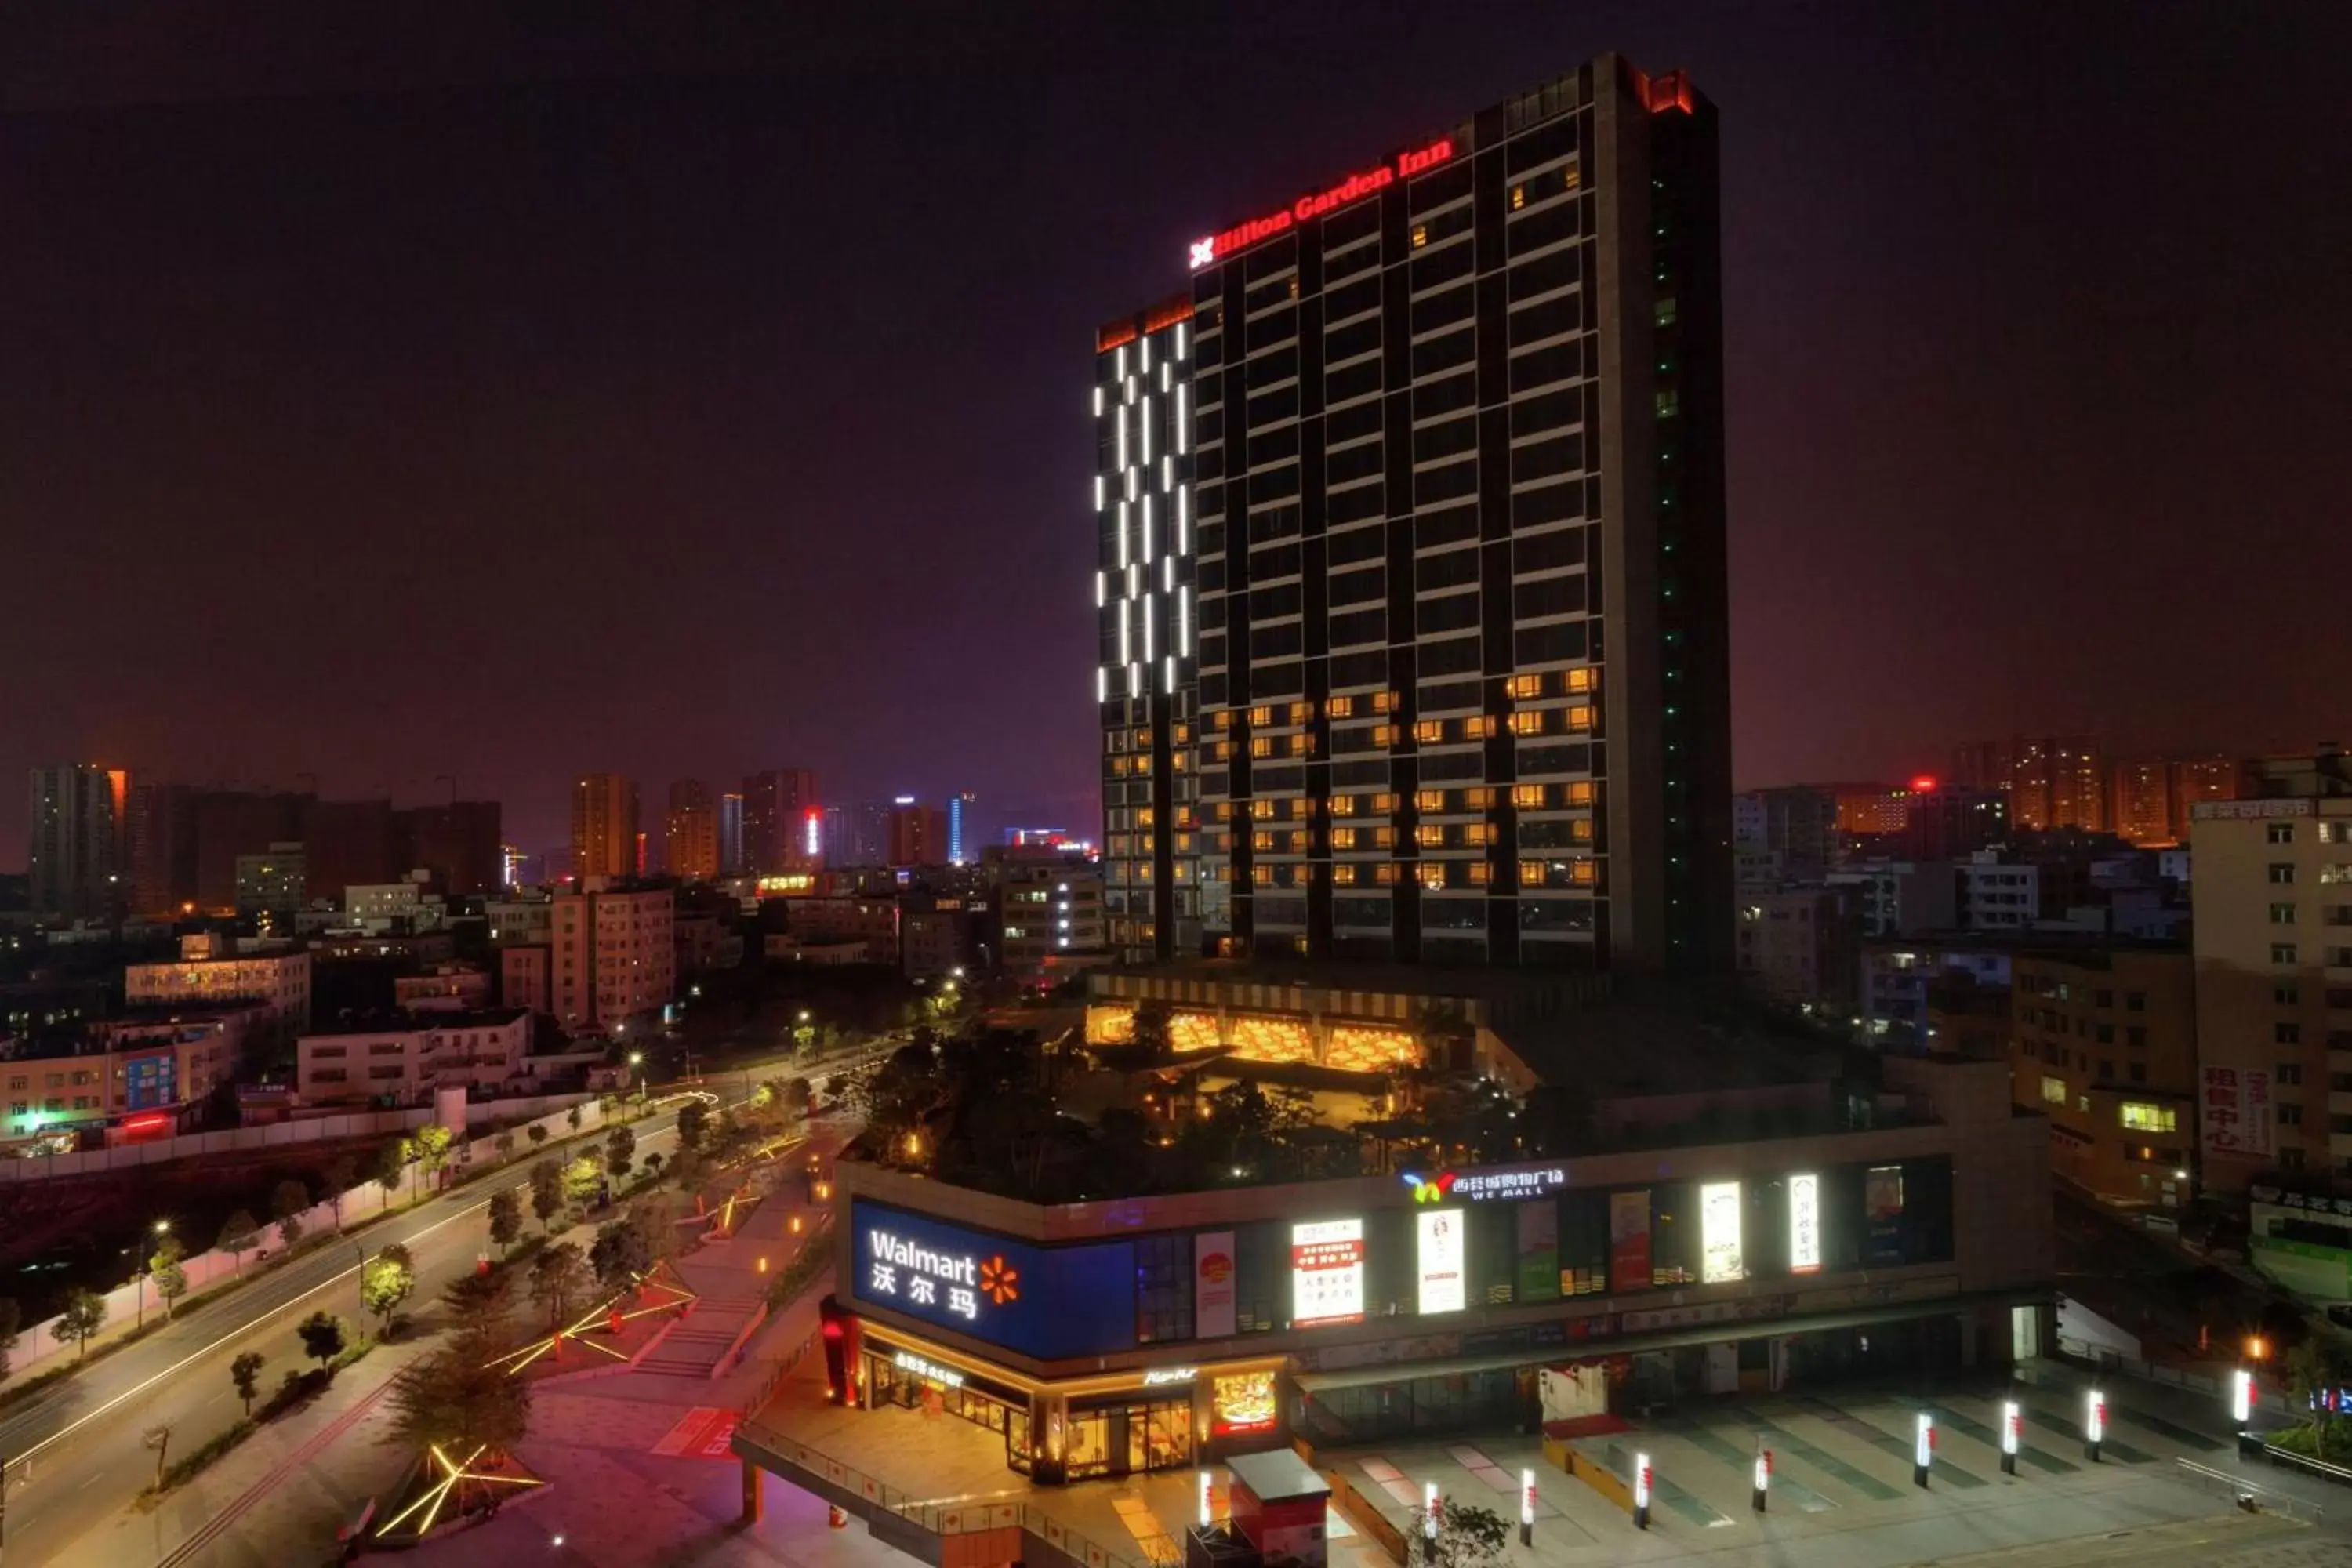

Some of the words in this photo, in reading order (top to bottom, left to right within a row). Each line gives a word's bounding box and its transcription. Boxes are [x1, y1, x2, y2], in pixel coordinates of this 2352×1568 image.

[1214, 209, 1292, 256] Hilton
[1295, 165, 1393, 220] Garden
[1399, 140, 1452, 176] Inn
[1472, 1191, 1494, 1200] WE
[1501, 1186, 1543, 1198] MALL
[871, 1229, 975, 1286] Walmart
[873, 1262, 978, 1319] 沃尔玛
